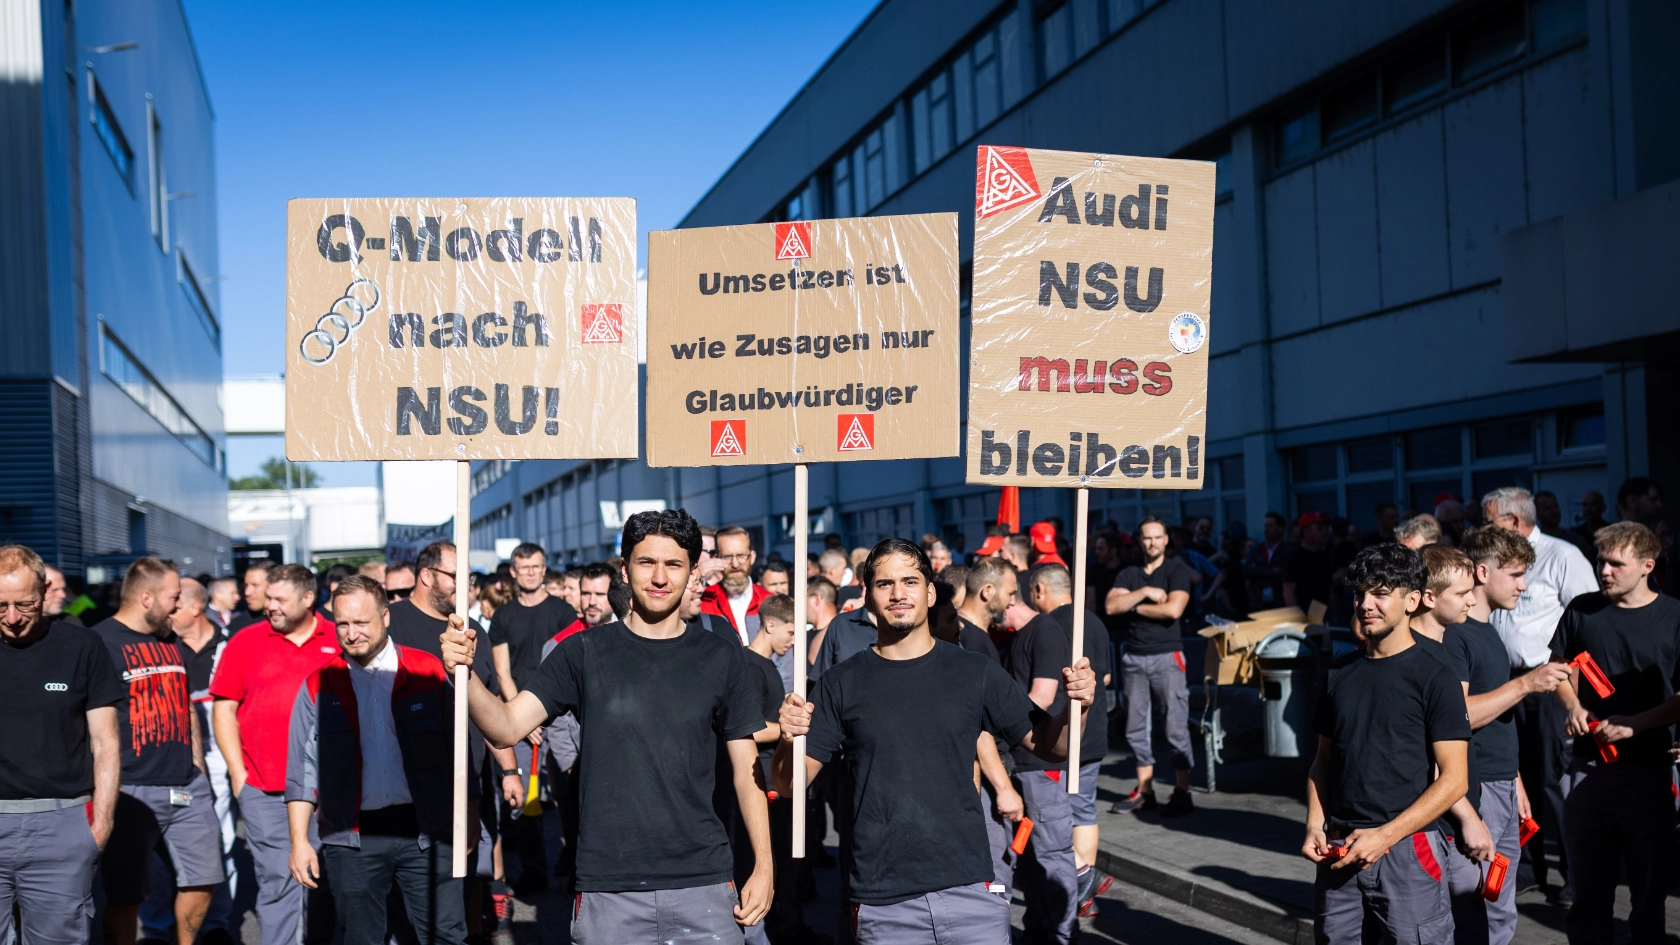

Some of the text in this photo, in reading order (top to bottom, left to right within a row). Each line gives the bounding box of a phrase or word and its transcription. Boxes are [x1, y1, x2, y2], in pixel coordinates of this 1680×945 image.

[1038, 177, 1169, 231] Audi
[317, 213, 602, 266] Q-Modell
[699, 263, 906, 295] Umsetzen ist
[1038, 261, 1164, 313] NSU
[389, 301, 550, 349] nach
[671, 329, 935, 360] wie Zusagen nur
[685, 383, 918, 414] Glaubwürdiger
[1019, 356, 1173, 396] muss
[396, 383, 559, 436] NSU!
[979, 430, 1200, 480] bleiben!
